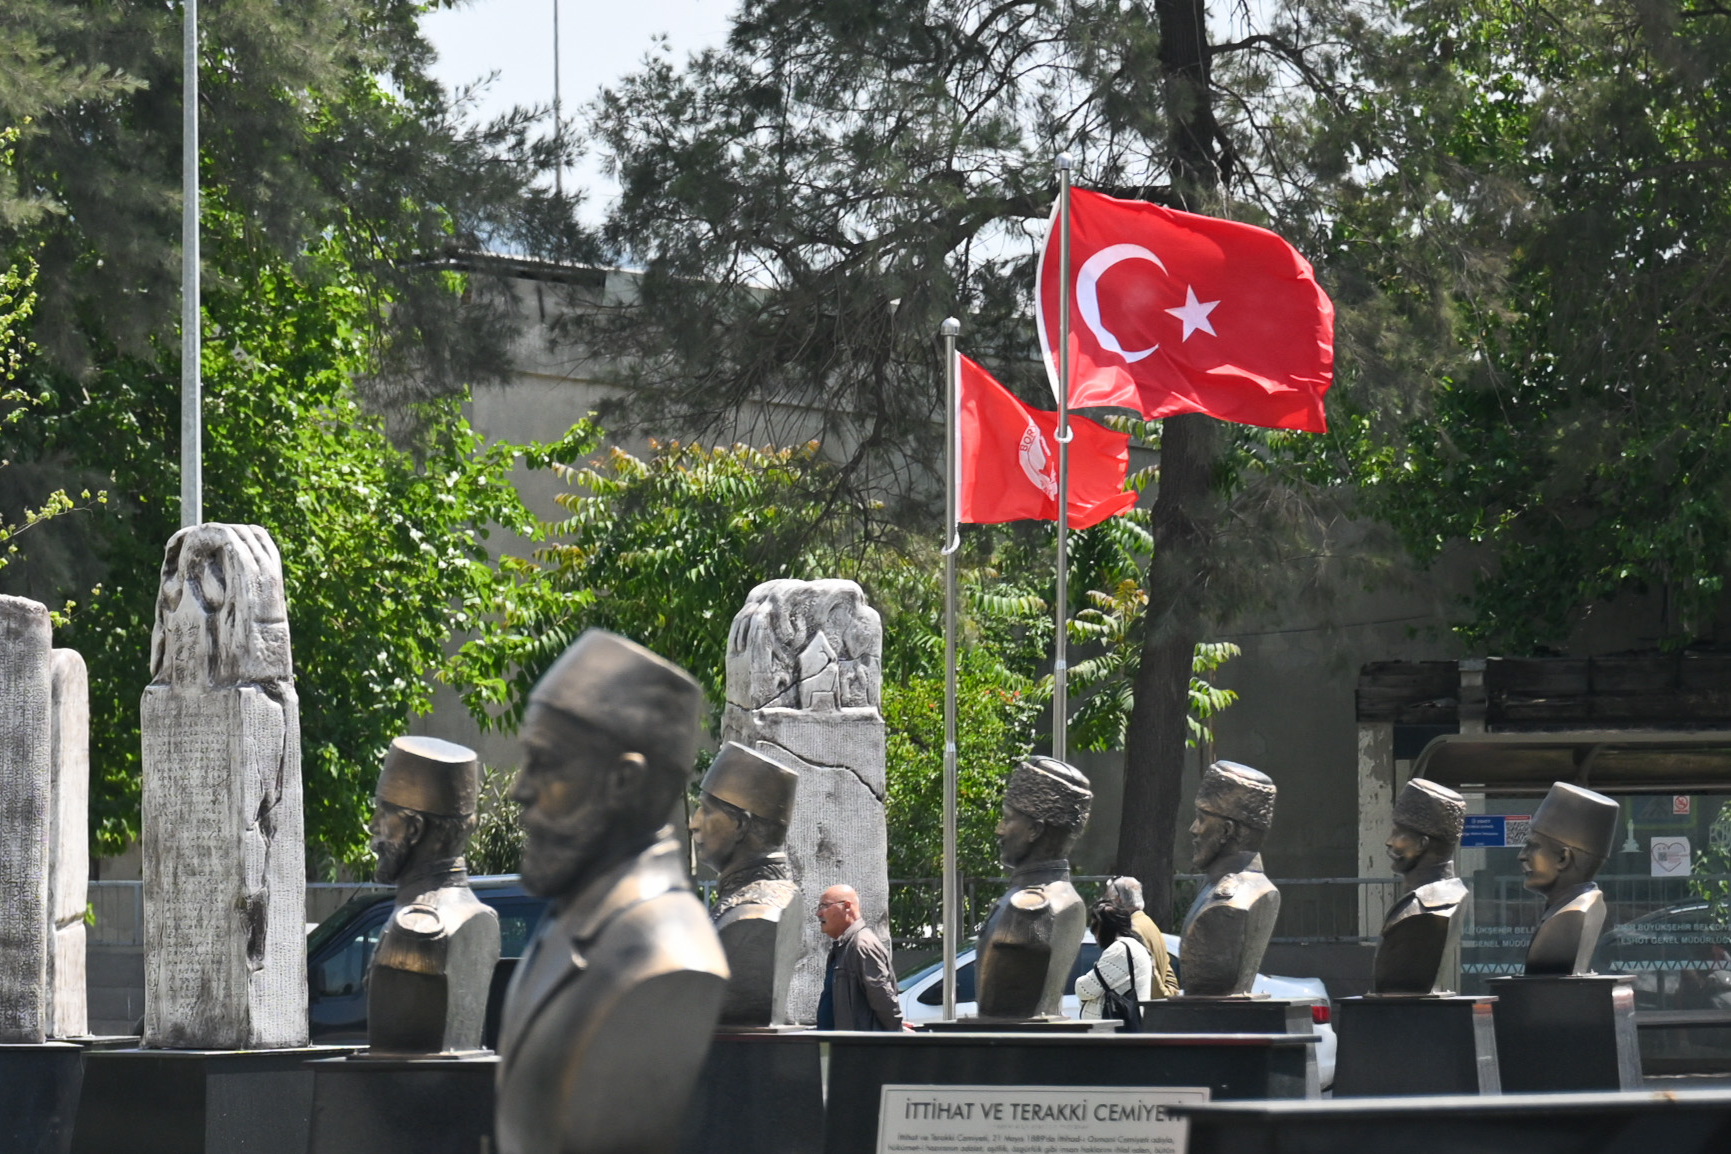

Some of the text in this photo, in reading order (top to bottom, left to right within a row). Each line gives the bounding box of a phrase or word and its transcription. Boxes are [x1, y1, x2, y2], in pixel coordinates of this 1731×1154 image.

[905, 1099, 974, 1119] İTTİHAT
[980, 1103, 1003, 1120] VE
[1011, 1100, 1088, 1121] TERAKKİ
